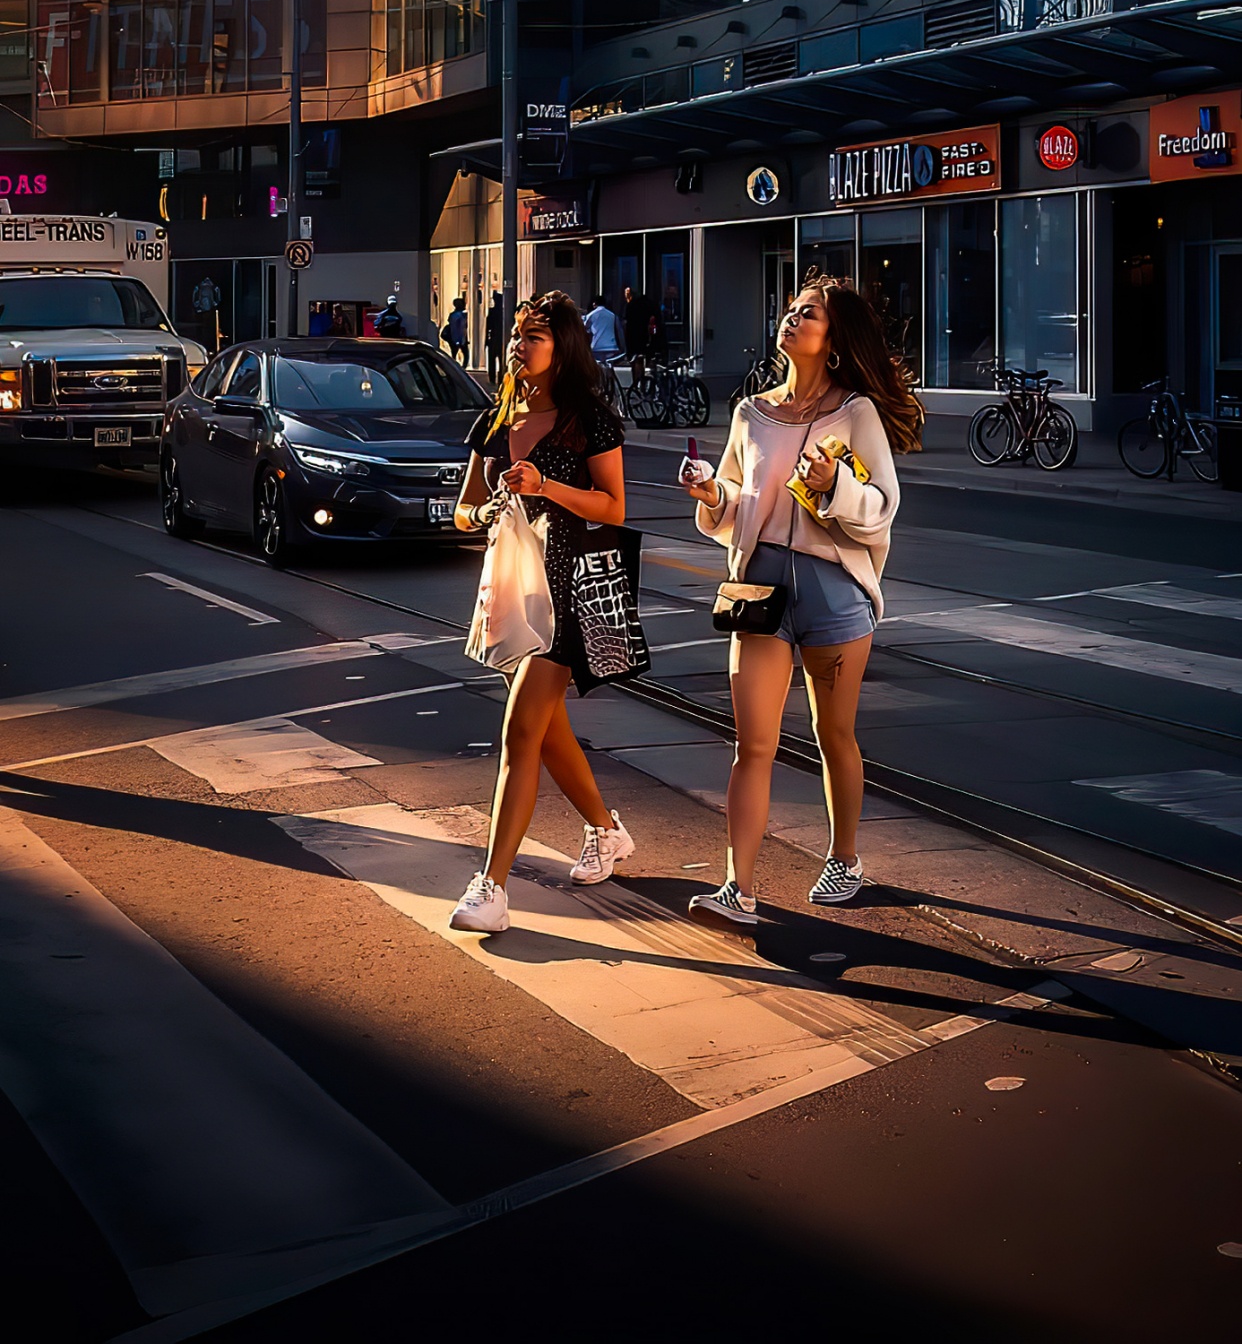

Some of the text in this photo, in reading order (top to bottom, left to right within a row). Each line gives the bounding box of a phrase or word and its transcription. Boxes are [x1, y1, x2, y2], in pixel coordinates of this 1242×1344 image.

[1159, 126, 1226, 156] Freedom
[829, 143, 911, 201] BLAZE PIZZA
